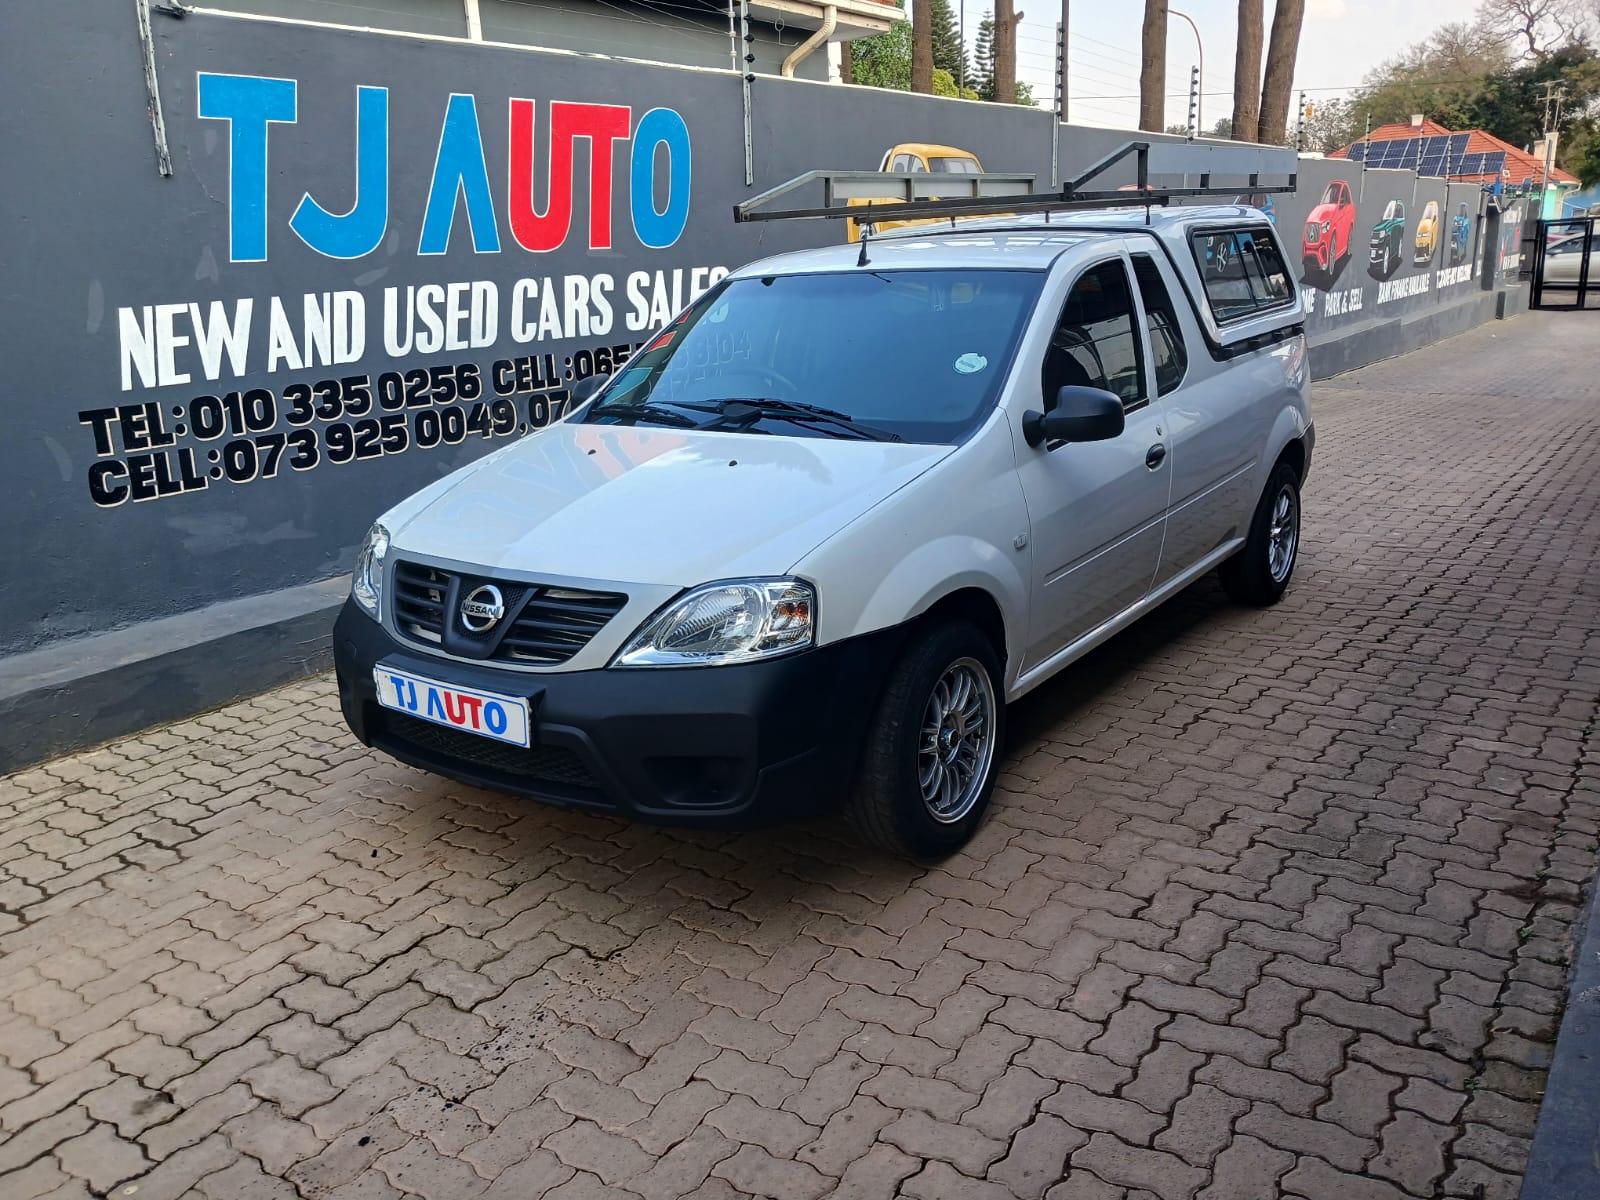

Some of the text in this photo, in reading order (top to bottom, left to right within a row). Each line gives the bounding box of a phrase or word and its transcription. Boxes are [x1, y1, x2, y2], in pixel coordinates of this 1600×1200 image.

[196, 71, 692, 263] TJ AUTO
[118, 298, 253, 391] NEW
[267, 291, 366, 373] AND
[384, 281, 499, 357] USED
[511, 273, 615, 343] CARS
[1324, 287, 1363, 318] PARK & SELL
[283, 374, 373, 426] 335
[377, 363, 482, 412] 0256
[325, 413, 410, 464] 925
[462, 602, 501, 618] NISSAN
[390, 676, 507, 735] TJ AUTO
